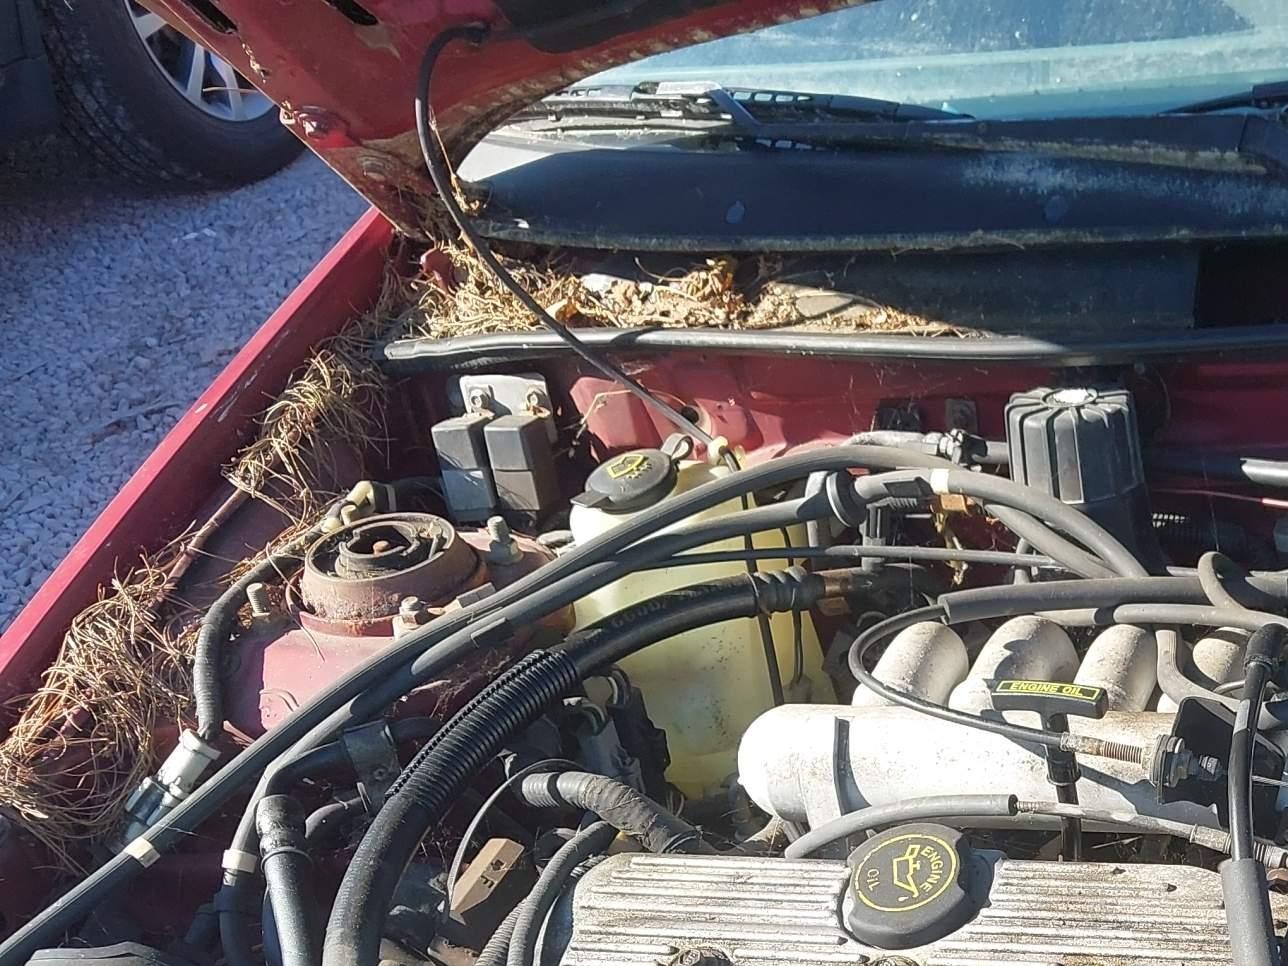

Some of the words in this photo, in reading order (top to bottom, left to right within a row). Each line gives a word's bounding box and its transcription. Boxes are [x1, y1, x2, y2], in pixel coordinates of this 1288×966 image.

[1009, 681, 1059, 693] ENGINE
[1062, 686, 1083, 696] OIL
[866, 868, 880, 891] OIL
[920, 845, 944, 892] ENGINE
